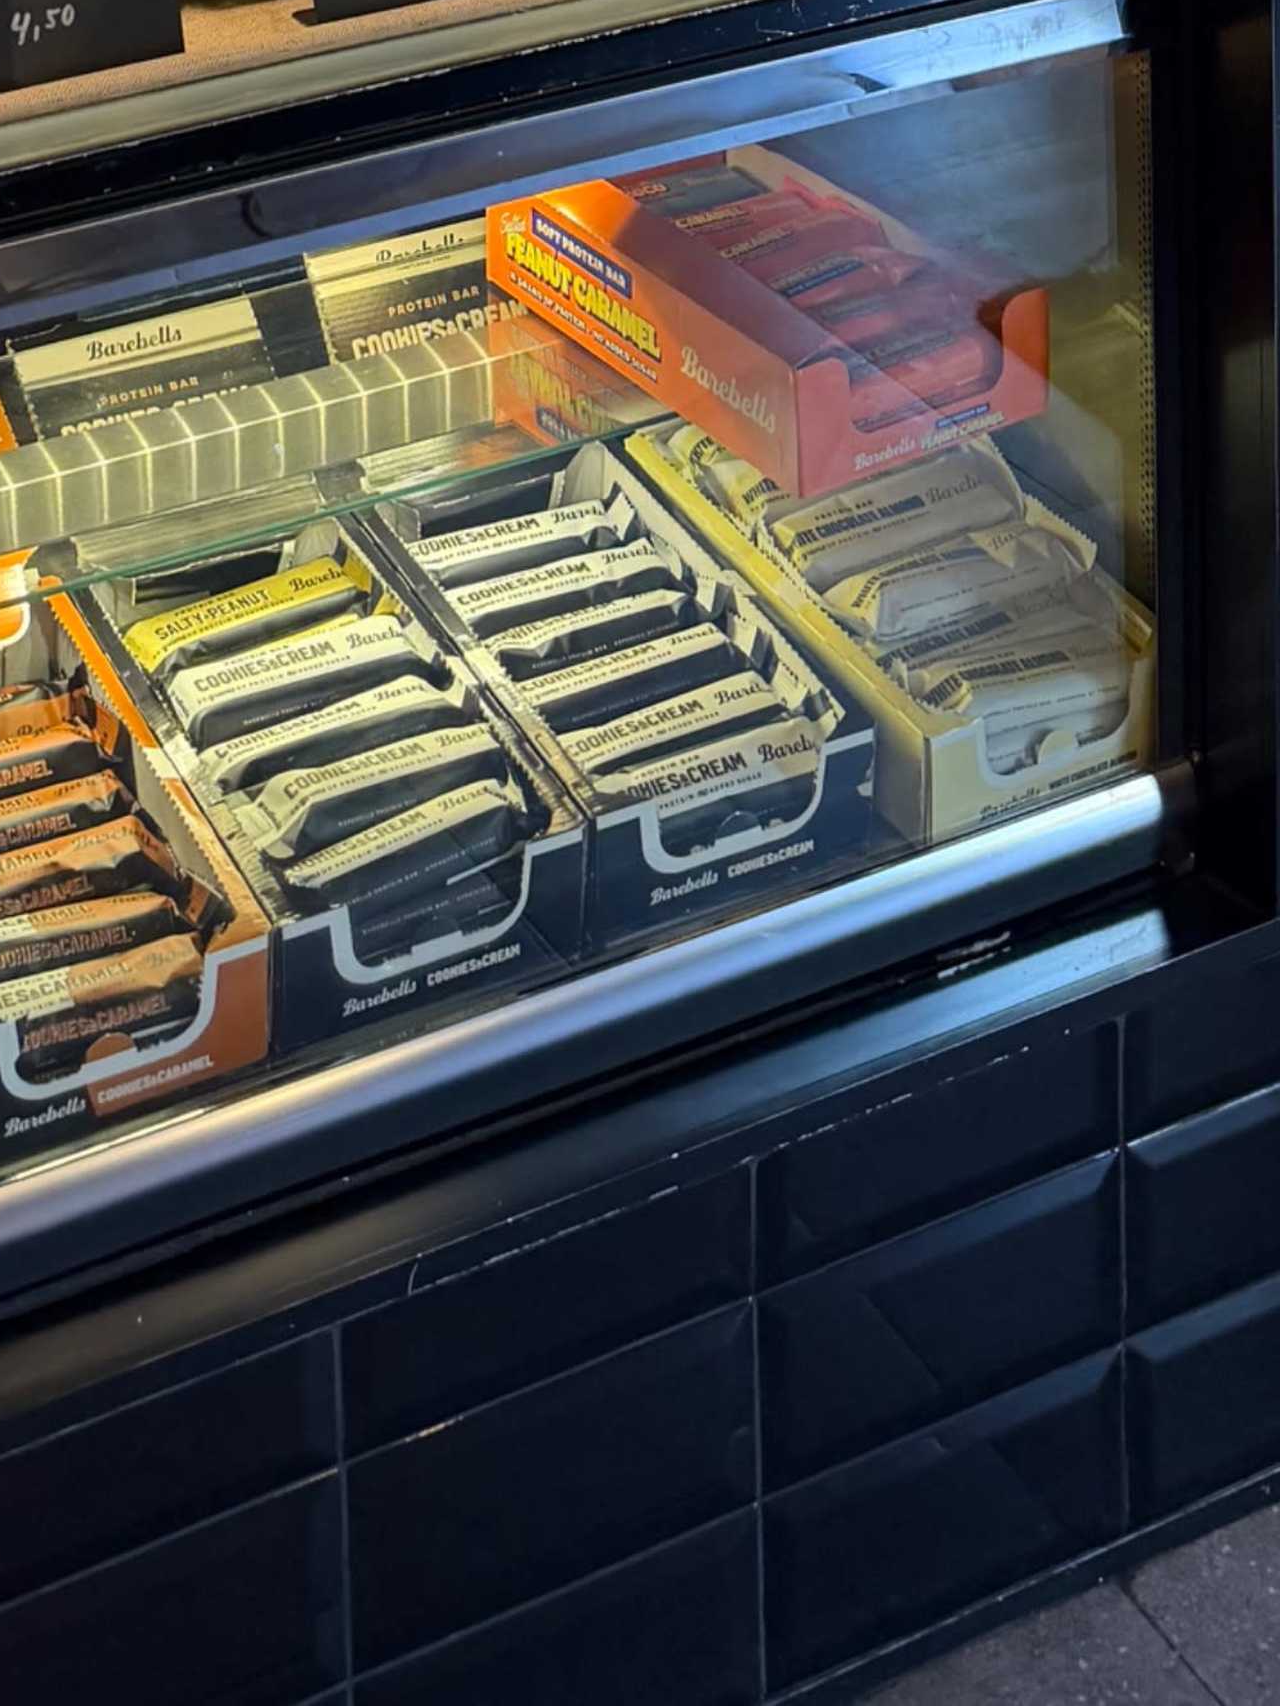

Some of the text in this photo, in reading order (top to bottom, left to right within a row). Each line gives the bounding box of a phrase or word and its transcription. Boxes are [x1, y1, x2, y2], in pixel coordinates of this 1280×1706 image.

[9, 2, 76, 47] 4,50
[386, 285, 481, 318] PROTEIN BAR
[505, 231, 578, 295] PEANUT
[573, 272, 663, 360] CARAMEL
[84, 323, 184, 363] Barebells
[168, 375, 200, 394] BAR
[680, 344, 777, 436] Barebells
[852, 438, 920, 473] Barebells
[650, 871, 720, 906] Barebells
[341, 977, 418, 1018] Barebells
[3, 1096, 87, 1140] Barebells
